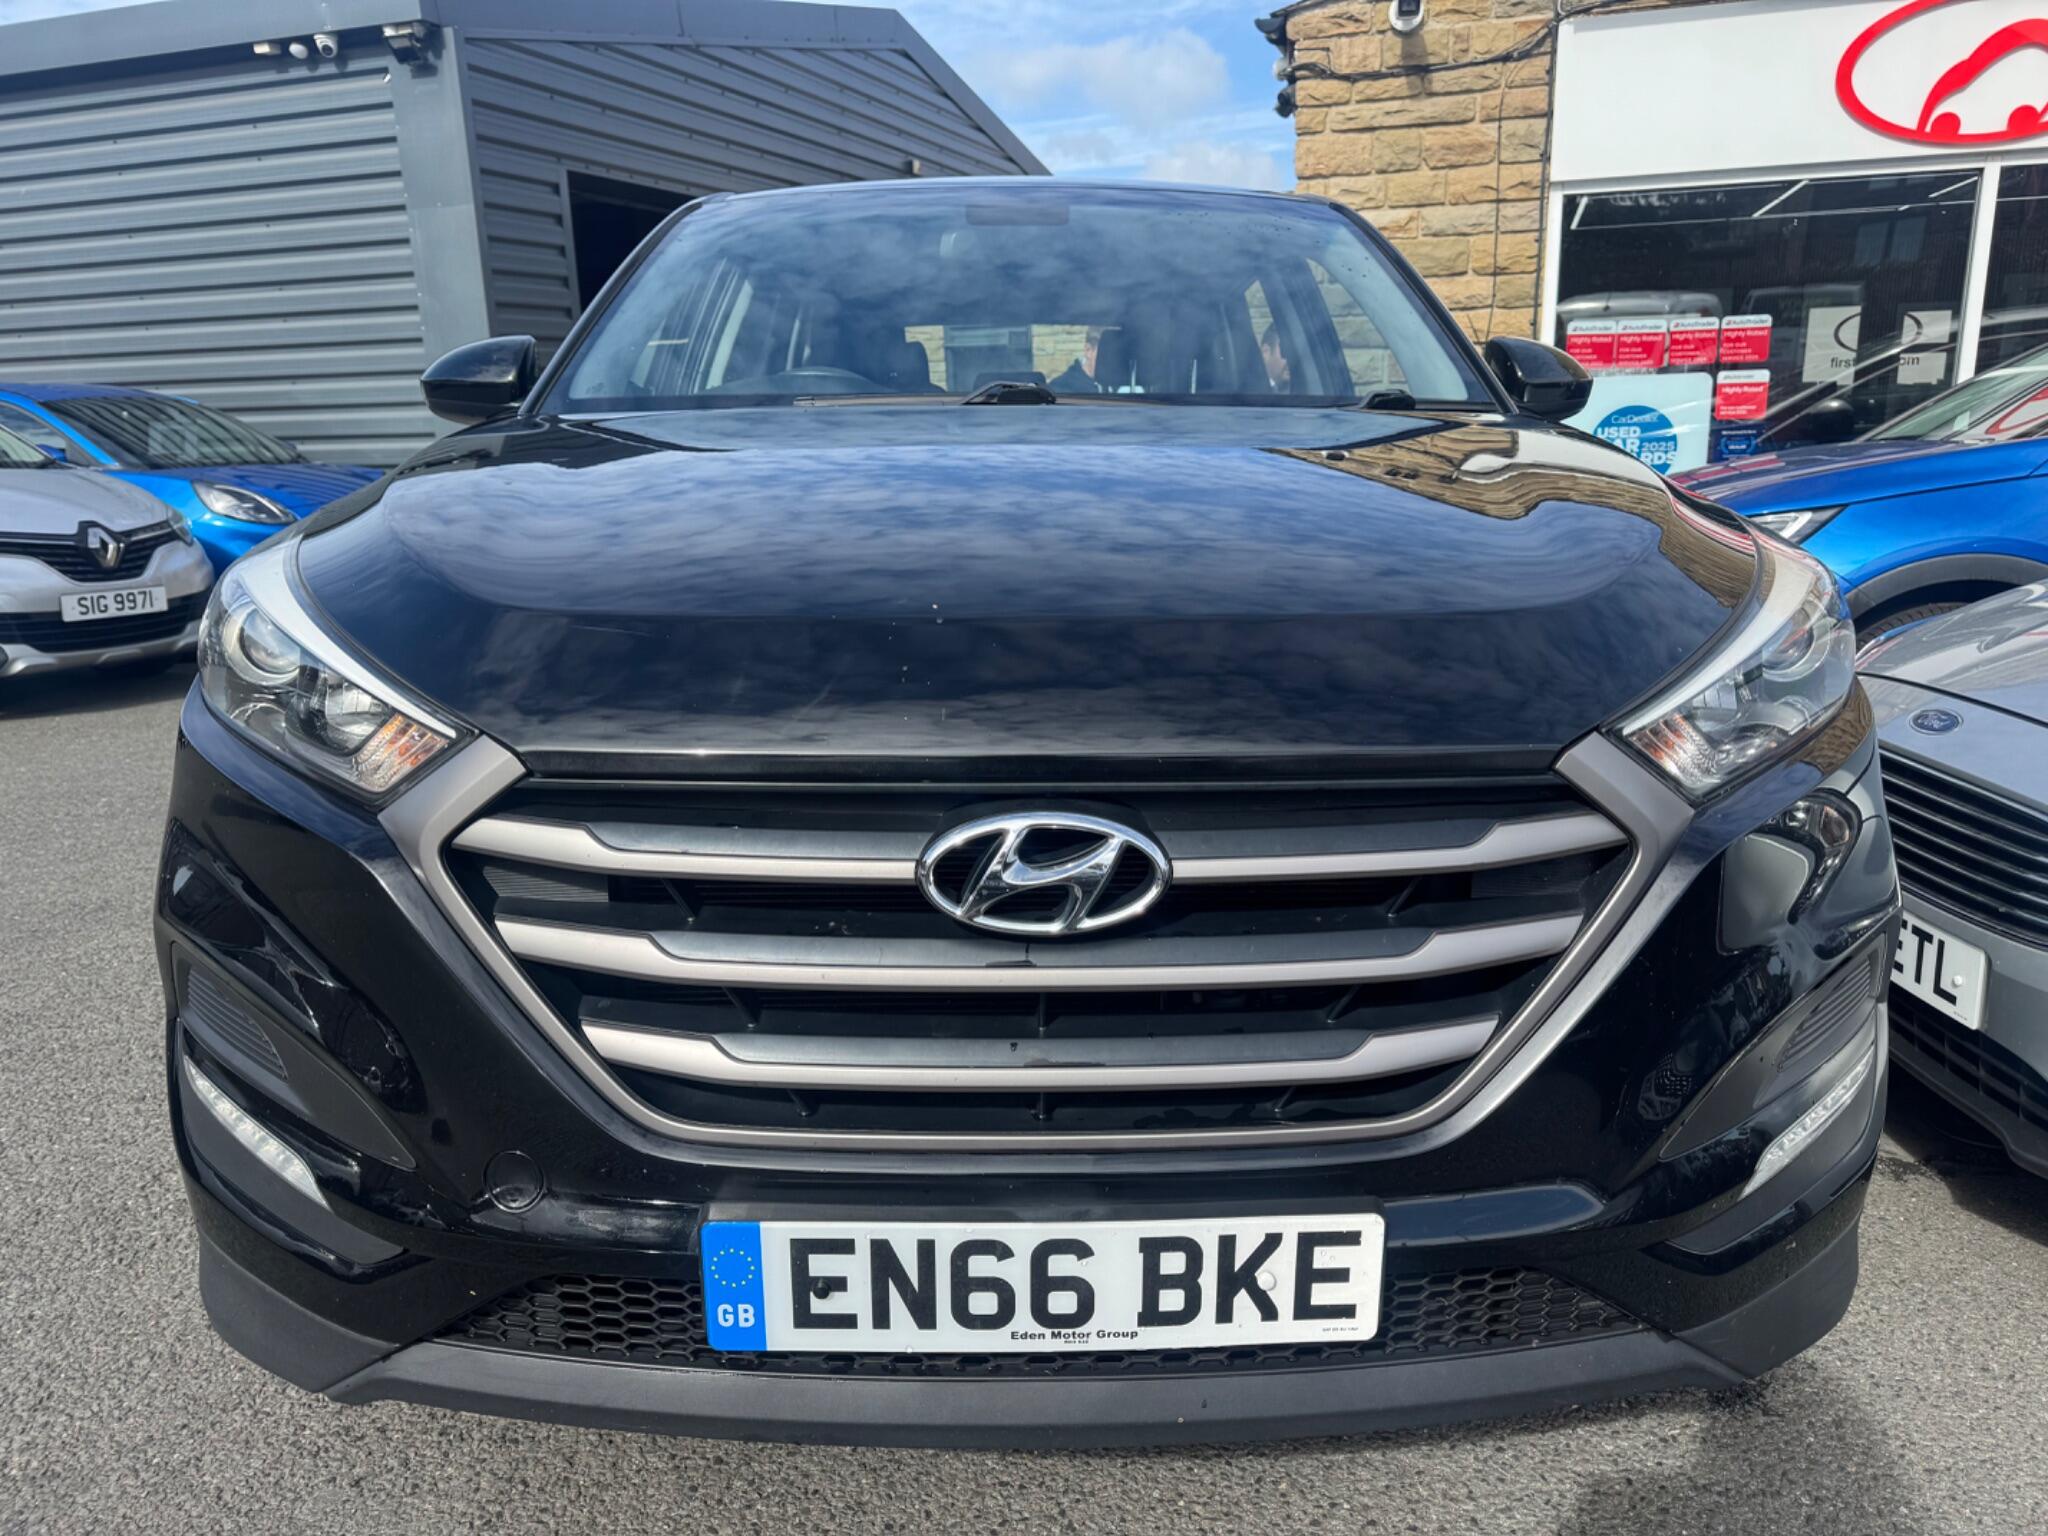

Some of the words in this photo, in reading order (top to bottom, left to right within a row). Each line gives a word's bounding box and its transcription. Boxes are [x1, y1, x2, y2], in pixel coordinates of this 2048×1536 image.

[1596, 426, 1641, 438] USED
[1611, 438, 1641, 453] AR
[1641, 441, 1675, 451] 2025
[77, 594, 109, 616] SIG
[114, 590, 153, 611] 9971
[790, 1237, 1096, 1330] EN66
[1138, 1231, 1362, 1327] BKE
[717, 1302, 756, 1327] GB
[1010, 1331, 1046, 1341] Eden
[1050, 1330, 1092, 1340] Motor
[1096, 1329, 1139, 1340] Group
